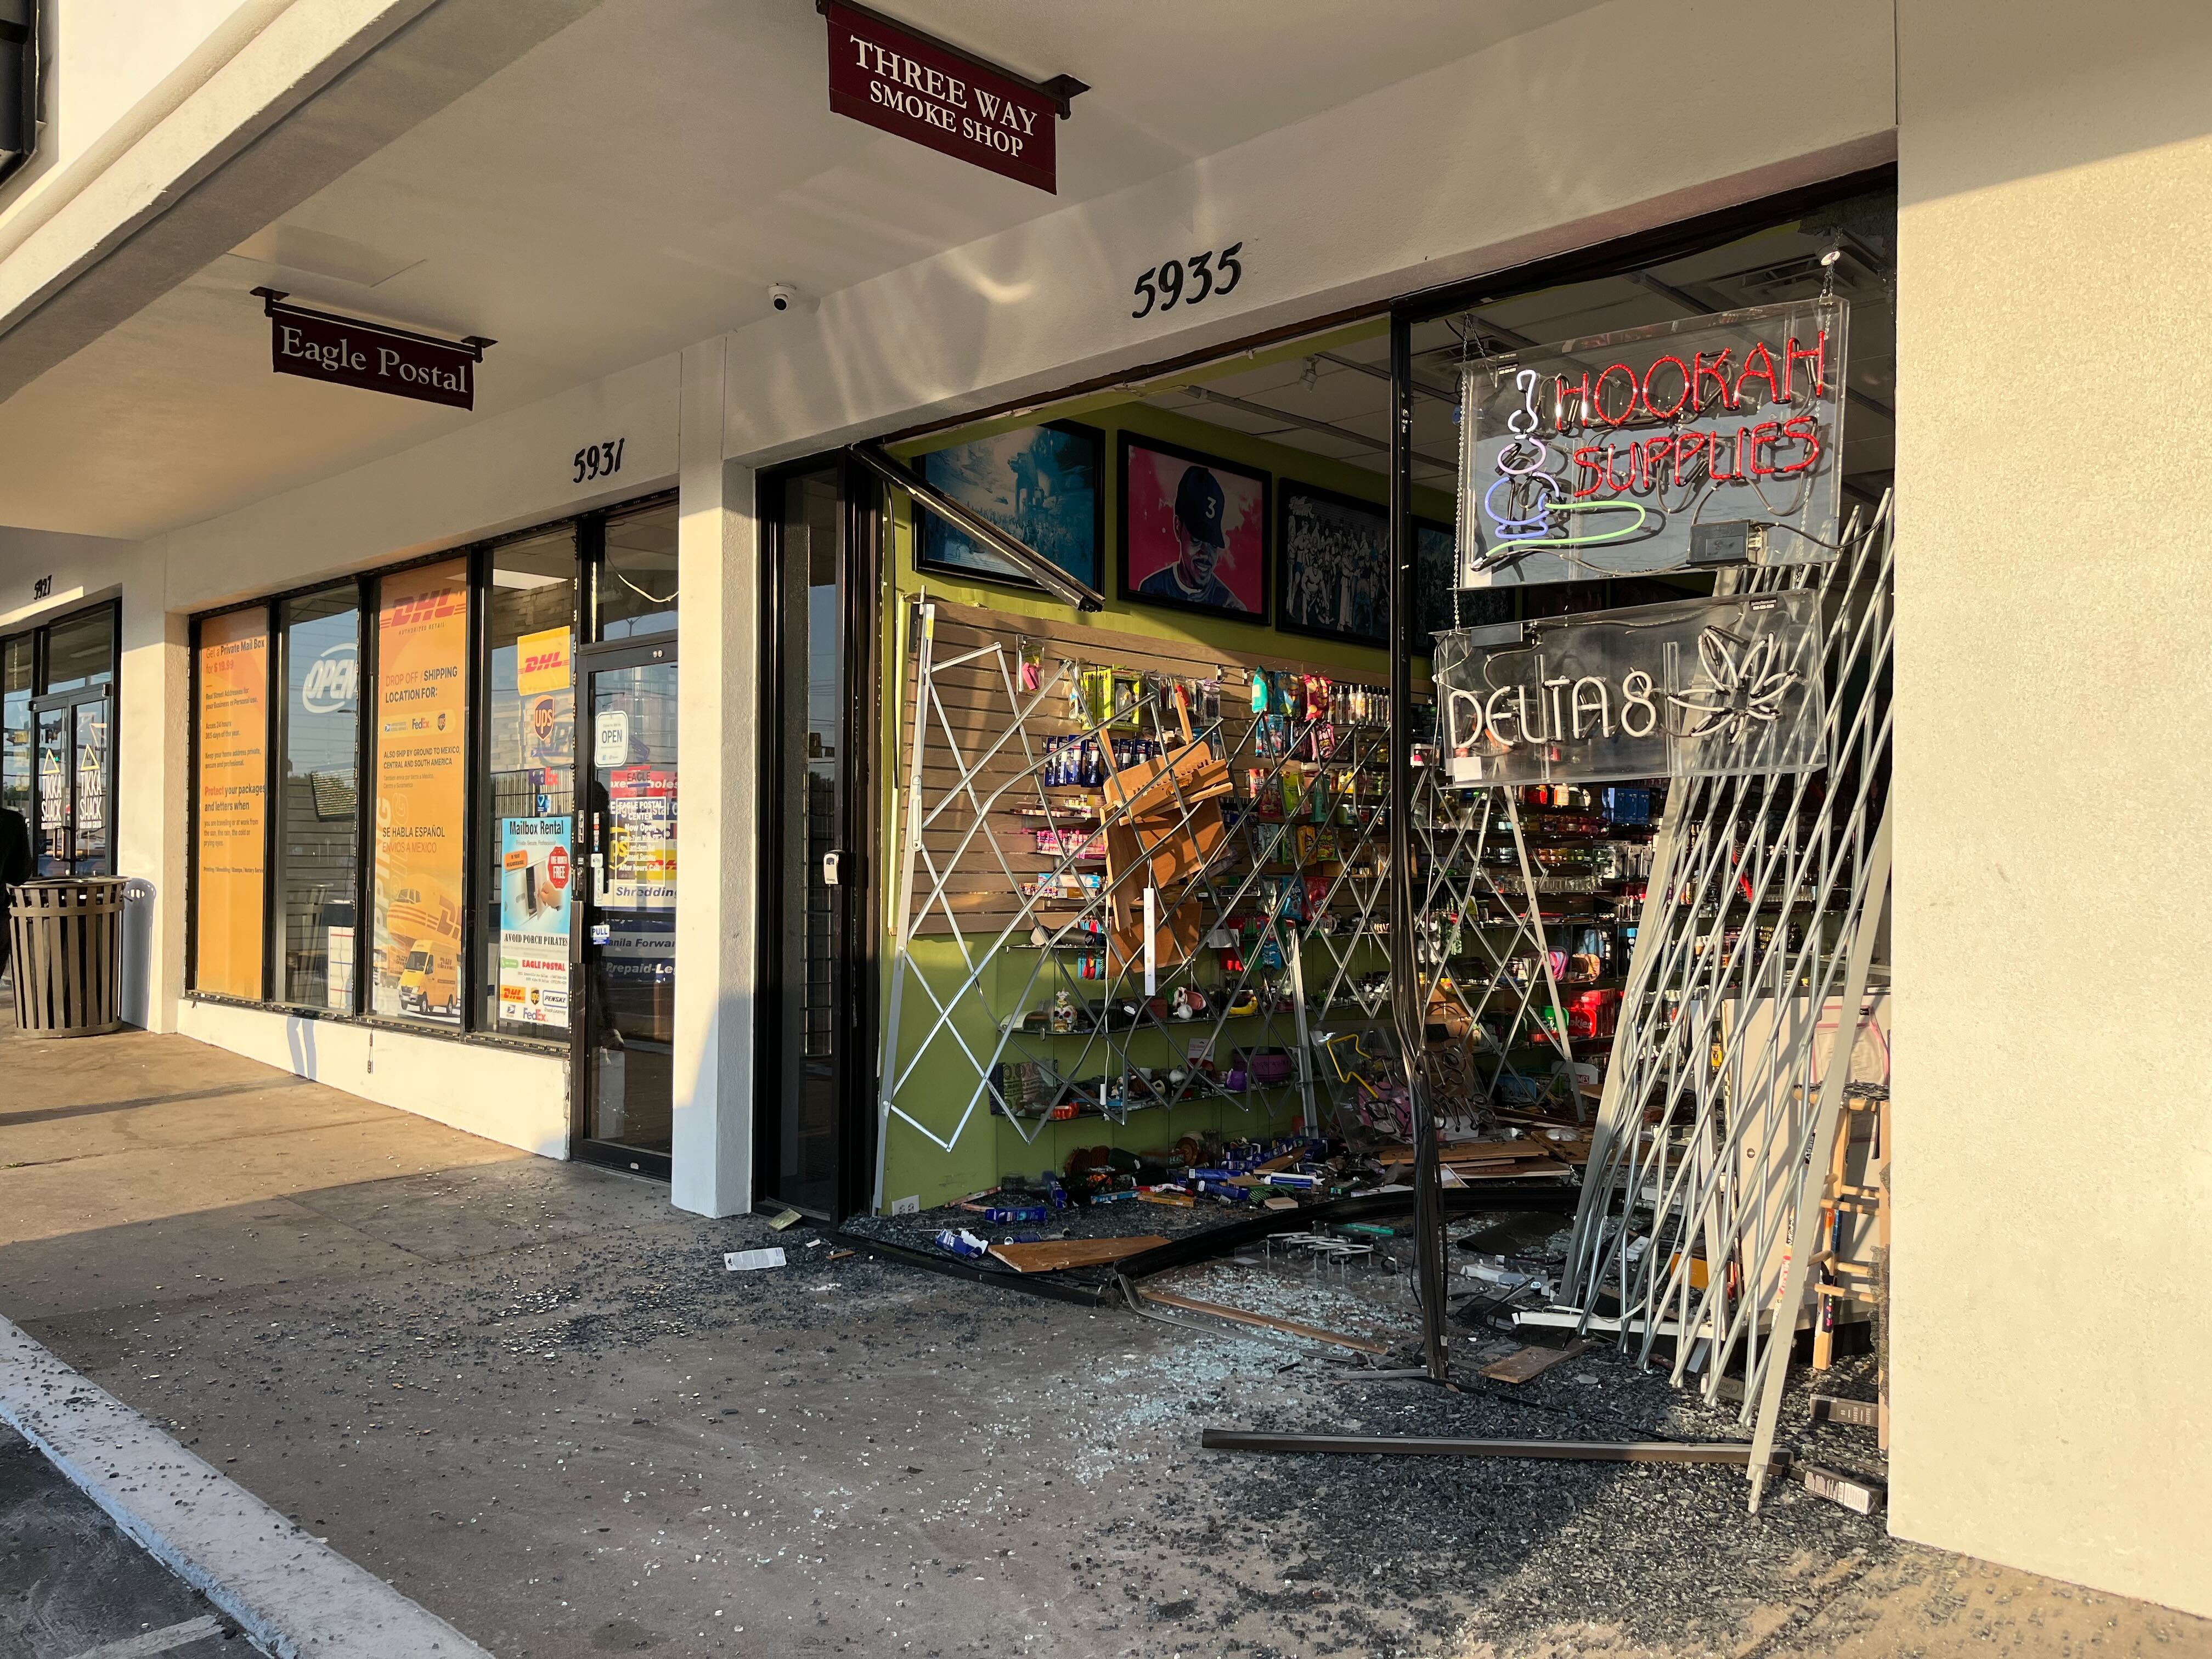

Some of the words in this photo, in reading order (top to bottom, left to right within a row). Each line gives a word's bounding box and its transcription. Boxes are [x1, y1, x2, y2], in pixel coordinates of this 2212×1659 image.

[850, 35, 967, 109] THREE
[974, 87, 1037, 136] WAY
[870, 80, 957, 133] SMOKE
[963, 117, 1023, 157] SHOP
[1132, 241, 1243, 319] 5935
[280, 325, 367, 371] Eagle
[377, 347, 468, 393] Postal
[1556, 330, 1825, 433] HOOKAH
[573, 437, 625, 483] 5931
[1573, 415, 1820, 498] SUPPLIES
[1205, 496, 1216, 519] 3
[33, 574, 52, 600] 5927
[391, 588, 455, 628] DHL
[398, 625, 427, 635] AUTHORIZED
[206, 648, 216, 659] Get
[221, 642, 240, 656] Private
[241, 638, 253, 652] Mail
[254, 638, 265, 650] Box
[524, 651, 562, 673] DHL
[386, 674, 404, 687] DROP
[405, 670, 419, 685] OFF
[424, 665, 458, 681] SHIPPING
[385, 687, 420, 704] LOCATION
[421, 686, 438, 698] FOR:
[1448, 675, 1610, 749] DELTA
[1621, 670, 1657, 738] 8
[412, 717, 430, 730] FedEx
[535, 709, 552, 735] ups
[602, 730, 623, 744] OPEN
[383, 750, 396, 759] ALSO
[396, 748, 406, 758] SHIP
[407, 748, 413, 757] BY
[414, 747, 433, 757] GROUND
[434, 747, 440, 755] TO
[383, 760, 403, 769] CENTRAL
[404, 759, 414, 768] AND
[414, 759, 430, 768] SOUTH
[431, 757, 452, 766] AMERICA
[80, 770, 102, 797] TIKKA
[627, 771, 651, 782] EAGLE
[42, 774, 62, 799] TIKKA
[205, 786, 224, 797] Protect
[224, 787, 238, 798] your
[41, 799, 62, 822] SHACK
[80, 797, 102, 821] SHACK
[205, 801, 214, 812] and
[215, 800, 233, 811] letters
[234, 799, 250, 811] when
[628, 812, 653, 821] CENTER
[382, 826, 391, 838] SE
[392, 826, 414, 838] HABLA
[414, 824, 445, 838] ESPAÑOL
[509, 820, 538, 835] Mailbox
[540, 820, 564, 835] Rental
[624, 823, 639, 832] Now
[382, 842, 405, 853] ENVIOS
[405, 842, 411, 853] A
[411, 842, 438, 854] MEXICO
[553, 866, 566, 879] FREE
[616, 887, 678, 897] Shreddin
[592, 927, 608, 936] PULL
[504, 933, 522, 943] AVOID
[523, 934, 543, 945] PORCH
[544, 936, 568, 947] PIRATES
[605, 938, 632, 947] anila
[522, 959, 541, 968] EAGLE
[542, 961, 566, 972] POSTAL
[606, 962, 675, 975] Prepaid-Le
[504, 988, 522, 1001] DHL
[545, 995, 566, 1003] PENSKE
[523, 1007, 546, 1022] FedEx
